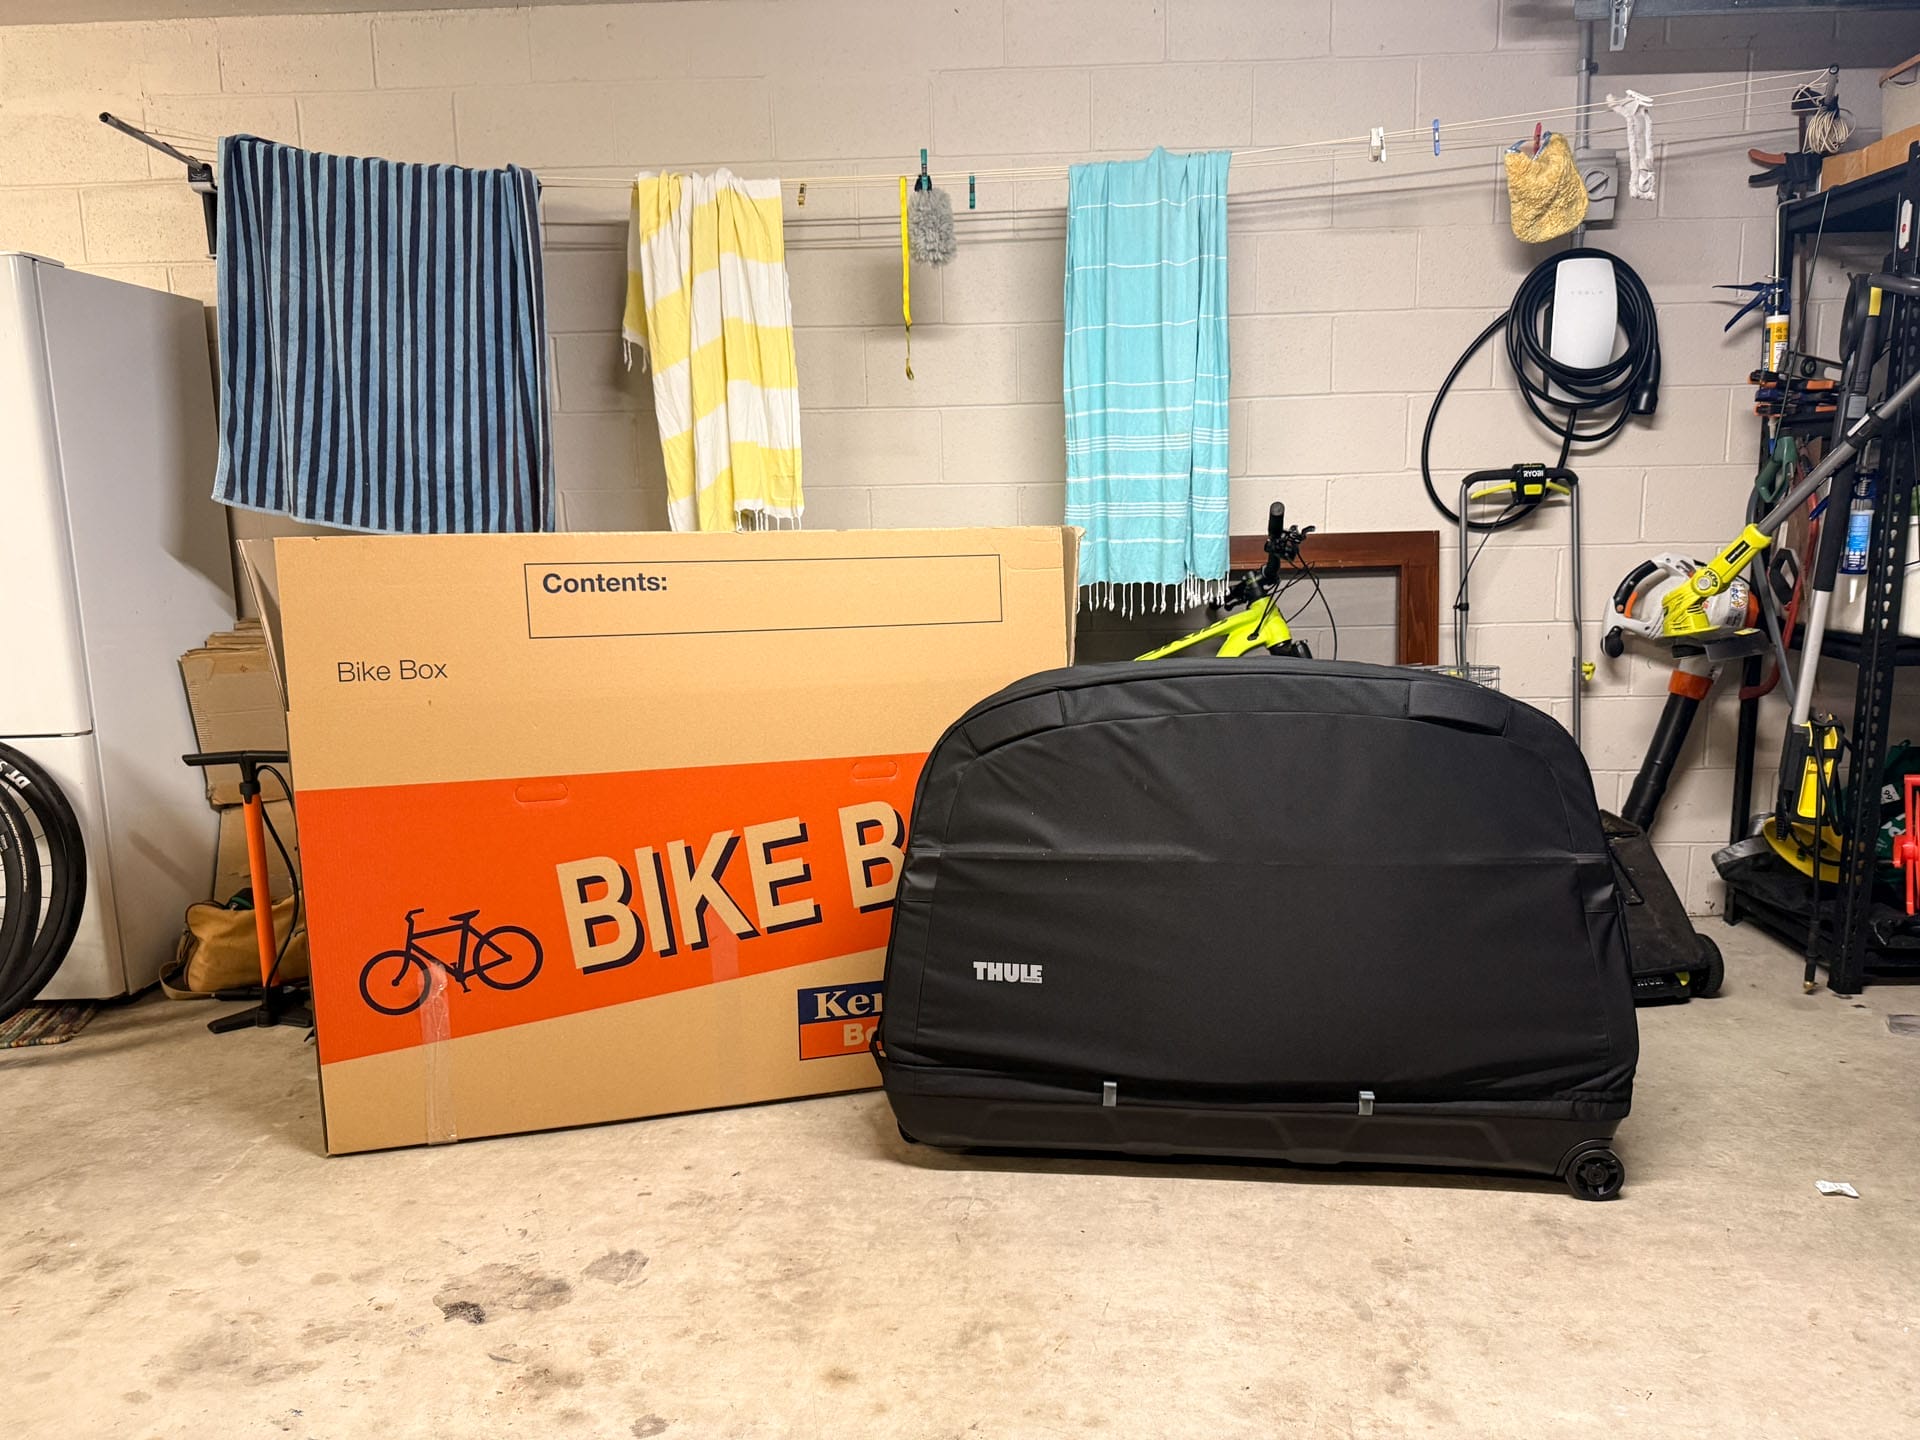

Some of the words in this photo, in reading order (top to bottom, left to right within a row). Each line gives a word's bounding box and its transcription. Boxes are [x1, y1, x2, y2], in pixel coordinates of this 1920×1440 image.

[1523, 469, 1544, 478] RYOBI
[542, 573, 667, 594] Contents:
[337, 661, 391, 682] Bike
[399, 659, 448, 681] Box
[556, 816, 823, 975] BIKE
[972, 961, 1043, 984] THULE
